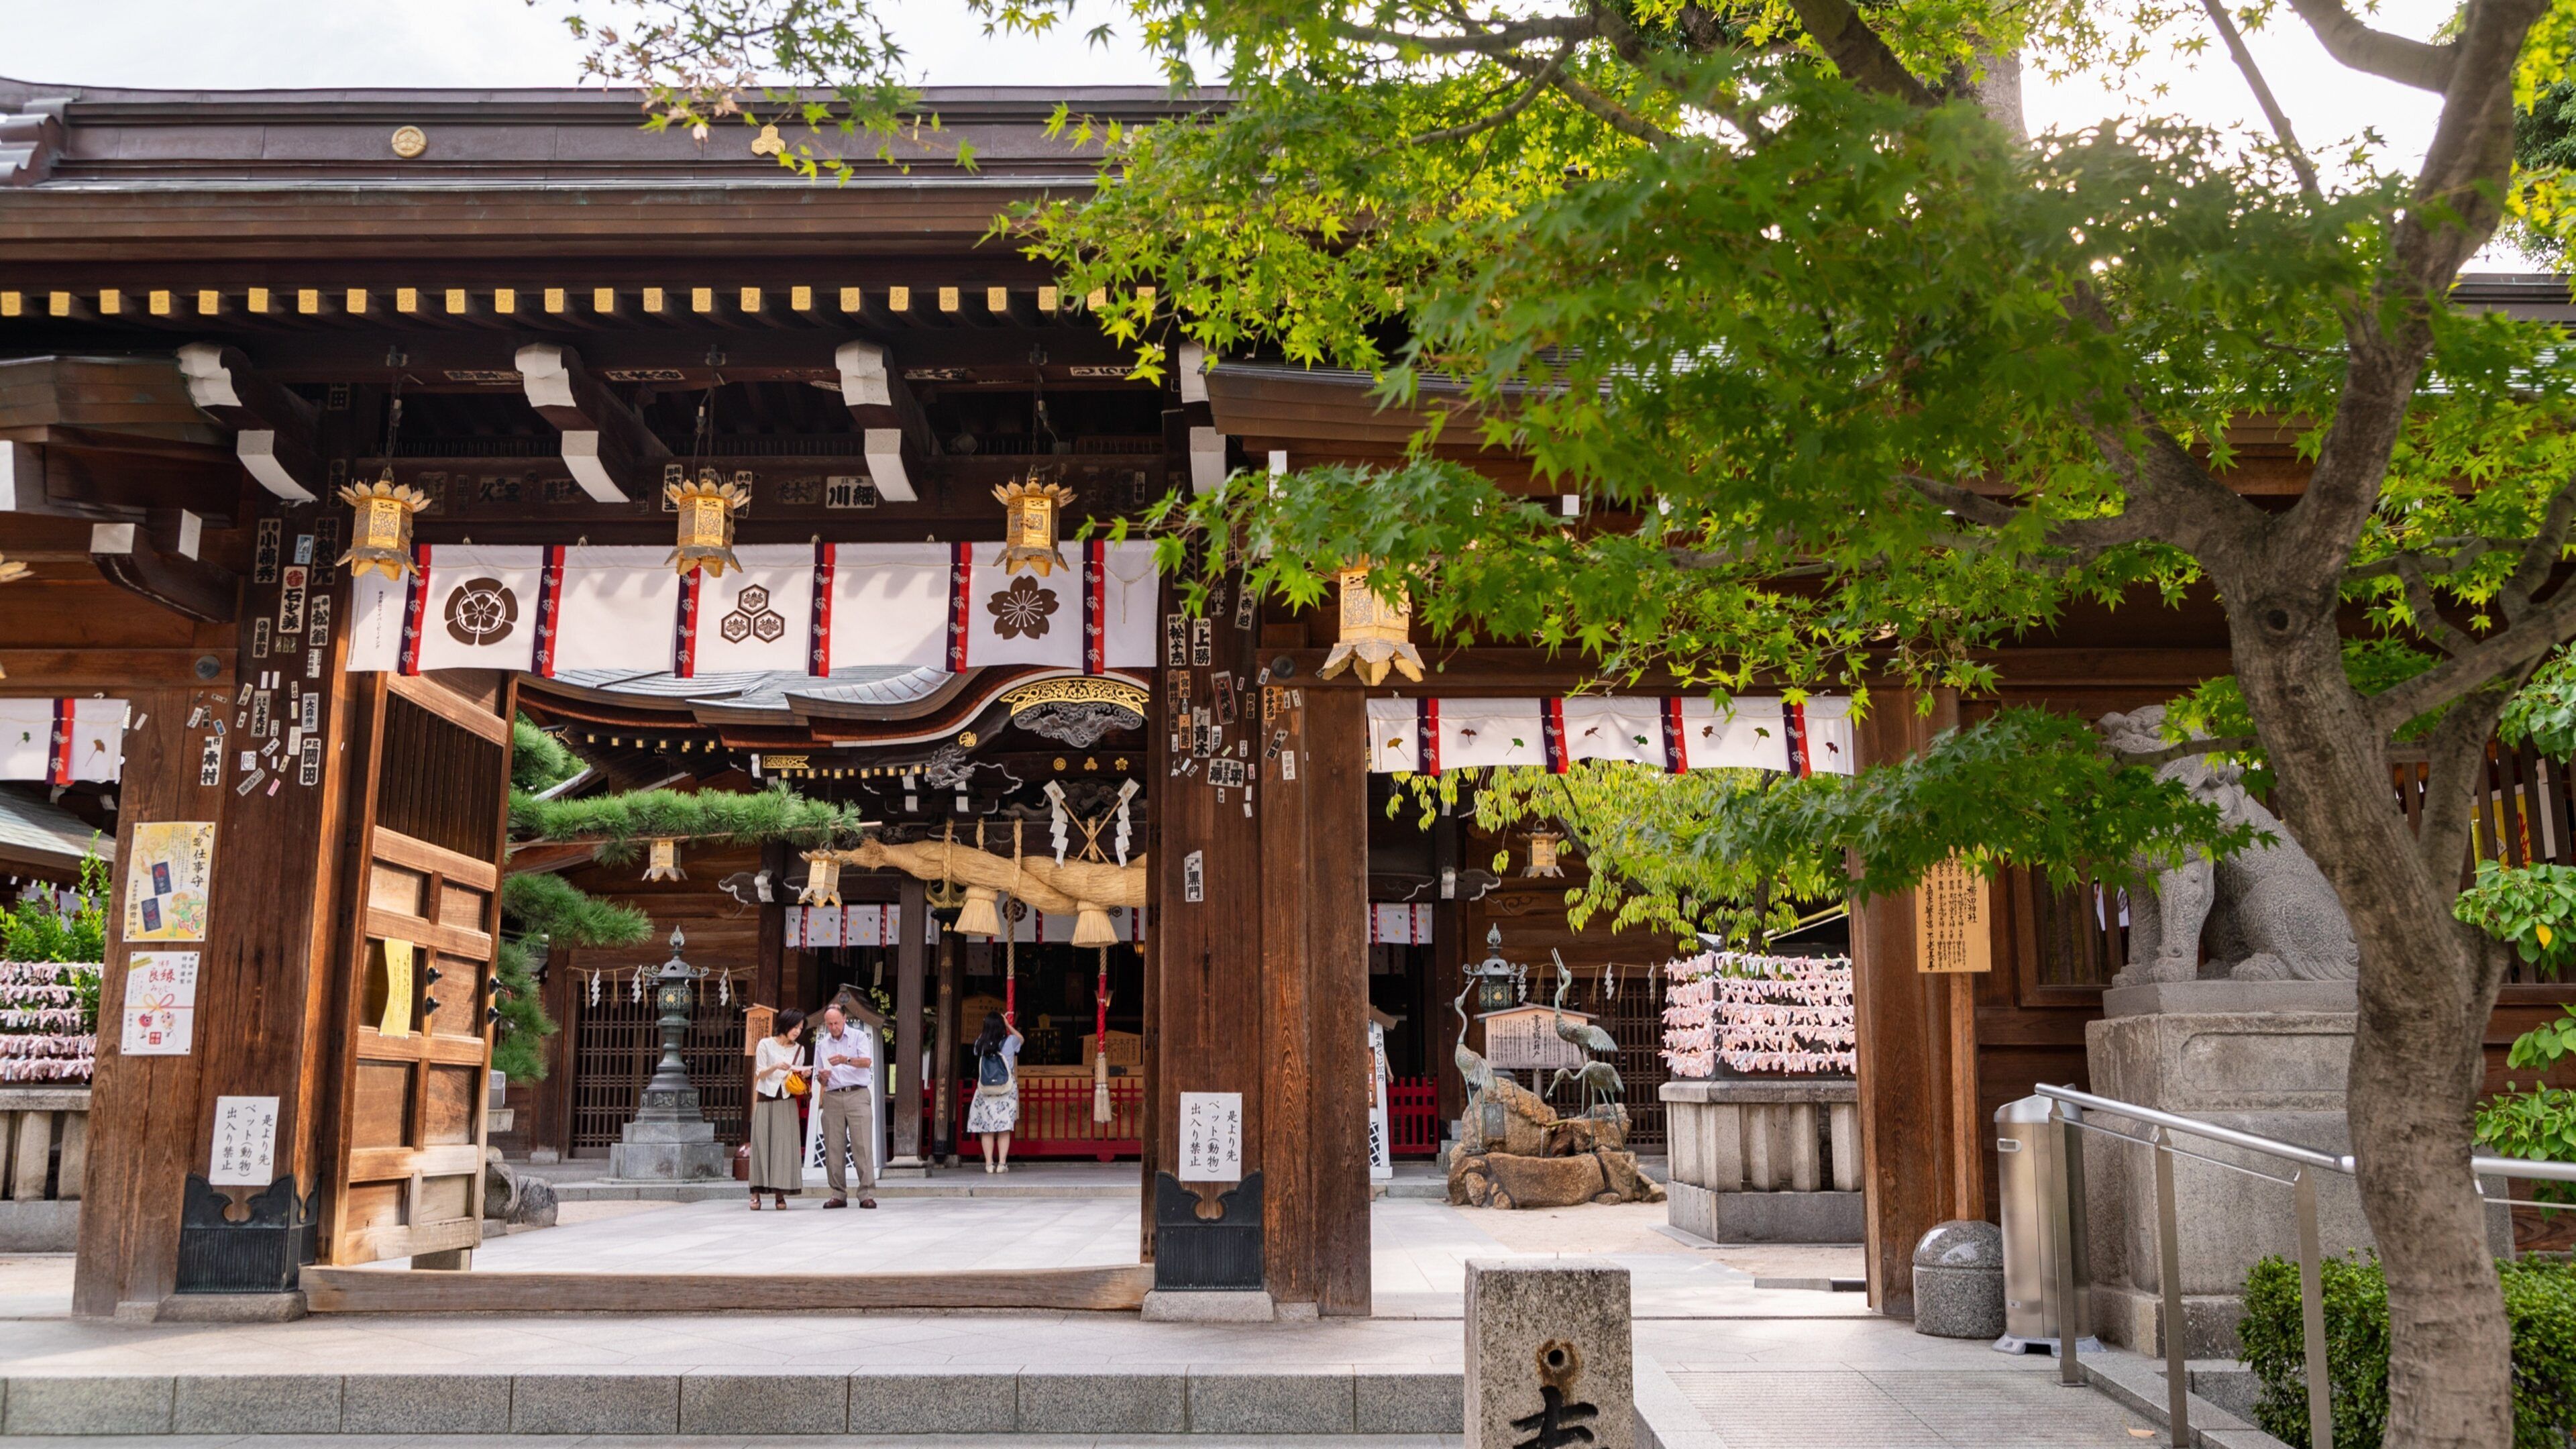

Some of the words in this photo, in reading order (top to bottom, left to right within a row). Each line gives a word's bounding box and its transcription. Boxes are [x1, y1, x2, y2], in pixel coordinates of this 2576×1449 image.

[1194, 628, 1210, 665] 上勝
[305, 700, 315, 729] 大森秀一
[305, 740, 319, 748] 江戸
[1194, 724, 1209, 757] 青木
[303, 748, 319, 784] 岡田
[1188, 871, 1199, 899] 黒門
[221, 1106, 237, 1171] 出入り禁止
[238, 1104, 256, 1177] ペット(動物)
[258, 1114, 273, 1167] 是より先
[1189, 1102, 1202, 1167] 出入り禁止
[1206, 1099, 1220, 1173] ペット(動物)
[1226, 1110, 1238, 1163] 是より先
